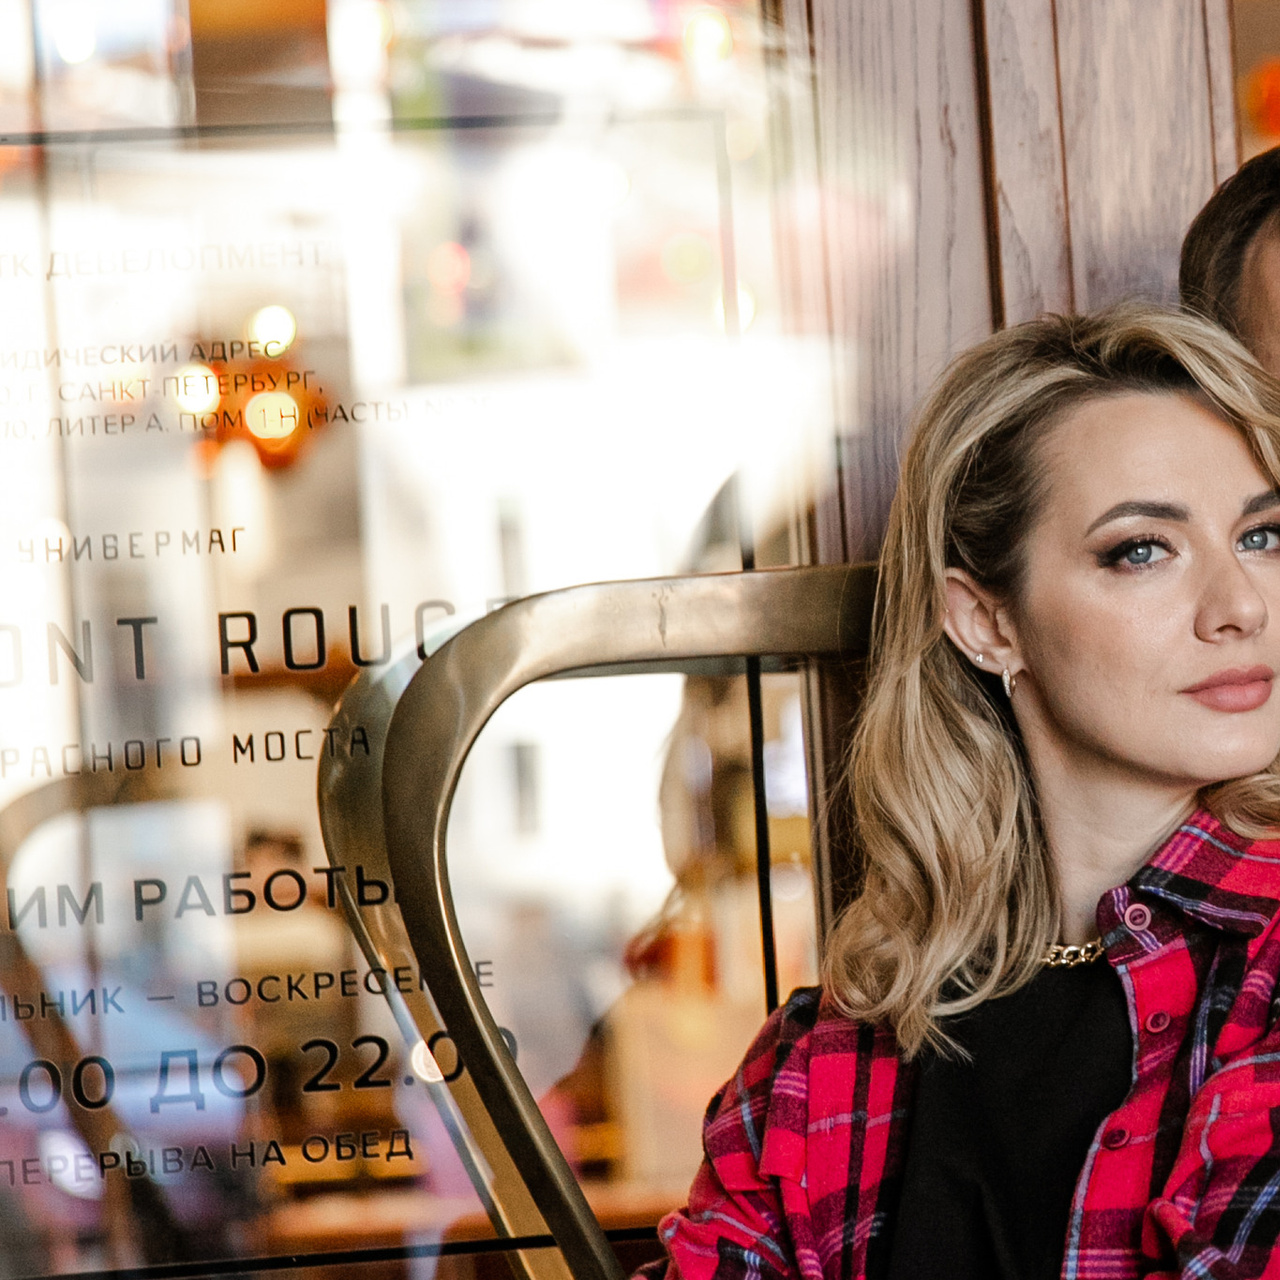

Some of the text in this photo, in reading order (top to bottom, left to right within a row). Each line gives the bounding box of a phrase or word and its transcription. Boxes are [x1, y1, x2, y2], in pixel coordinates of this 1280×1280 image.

[47, 413, 136, 438] ЛИТЕР
[18, 527, 246, 563] УНИВЕРМАГ
[232, 726, 371, 764] МОСТА
[150, 1043, 268, 1114] ДО
[231, 1139, 287, 1171] НА
[301, 1129, 415, 1163] ОБЕД
